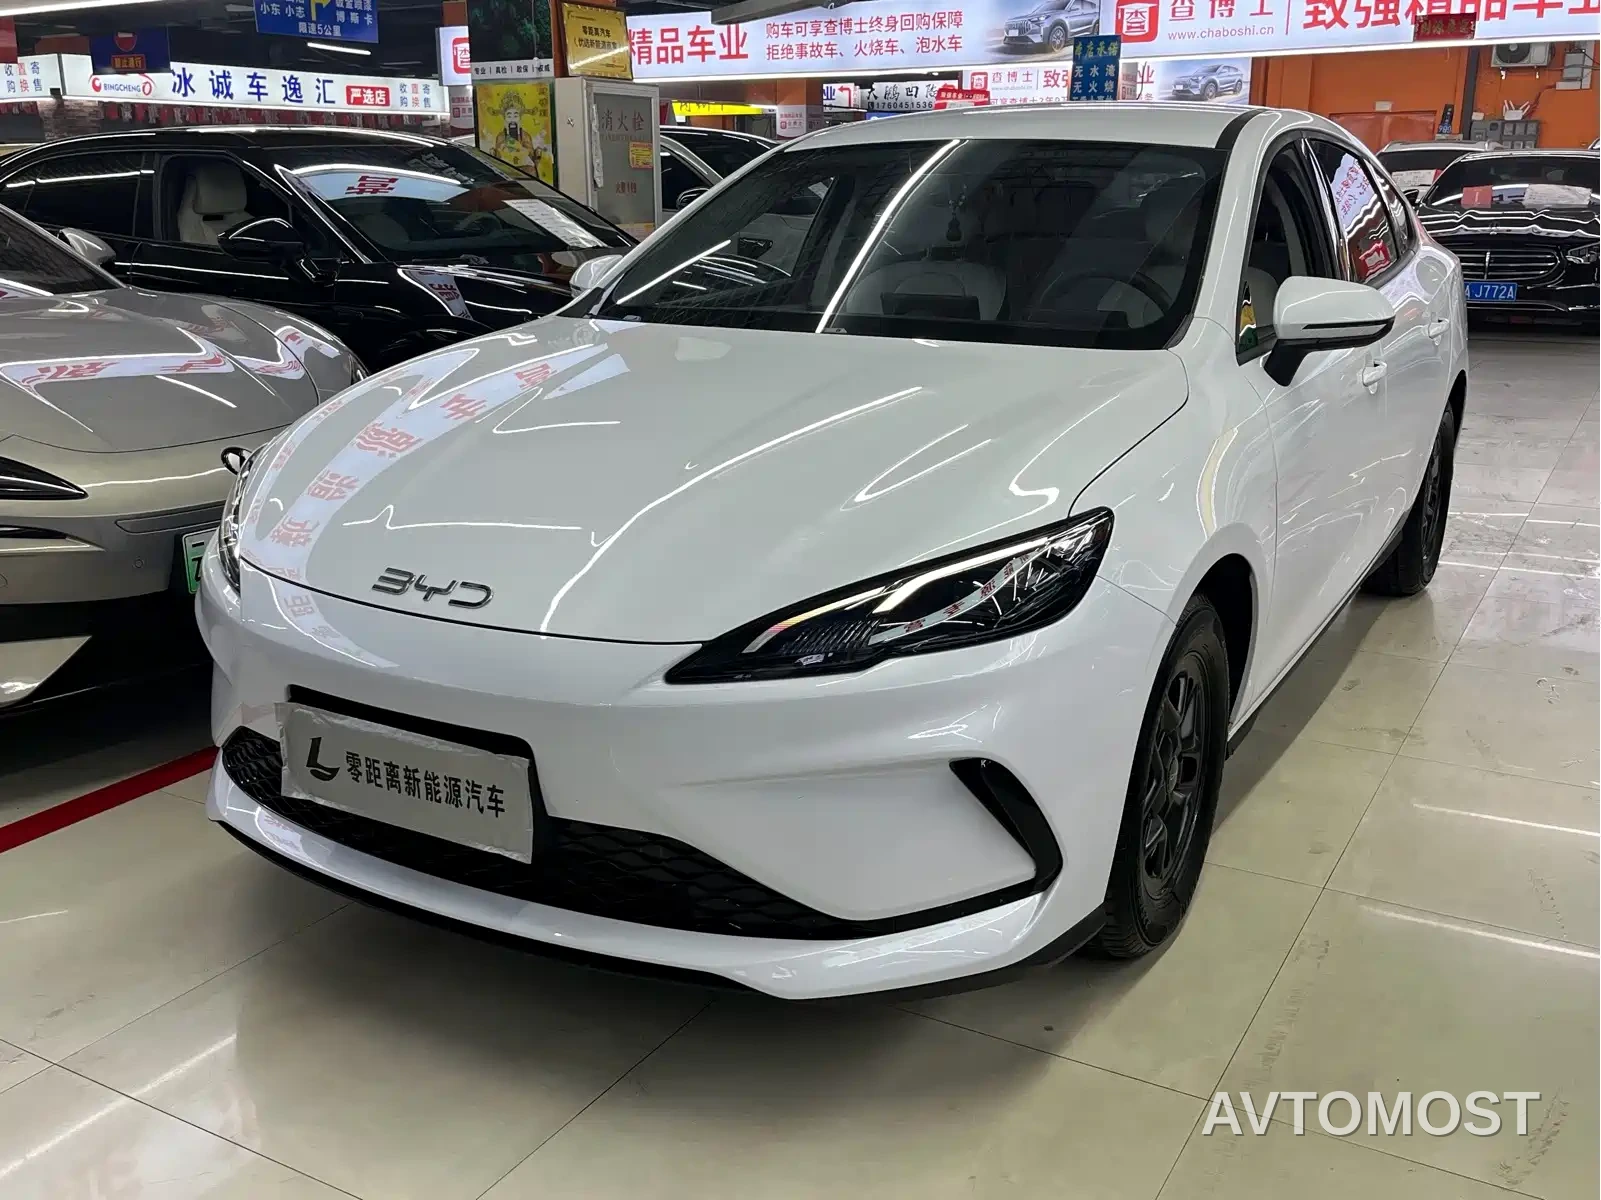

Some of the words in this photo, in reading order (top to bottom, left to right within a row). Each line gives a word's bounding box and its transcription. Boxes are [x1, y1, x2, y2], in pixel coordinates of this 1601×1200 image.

[299, 22, 342, 36] 限速5公里
[765, 10, 964, 39] 购车可享查博士终身回购保障
[1167, 25, 1275, 41] www.chaboshi.cn
[629, 23, 750, 65] 精品车业
[766, 34, 963, 61] 拒绝事故车、火烧车、泡水车
[103, 83, 141, 92] BINGCHENG
[171, 67, 336, 105] 冰诚车逸汇
[349, 88, 386, 105] 严选店
[601, 108, 645, 132] 消火栓
[1474, 284, 1514, 299] J772A
[371, 567, 495, 610] BYD
[345, 750, 506, 818] 零距离新能源汽车
